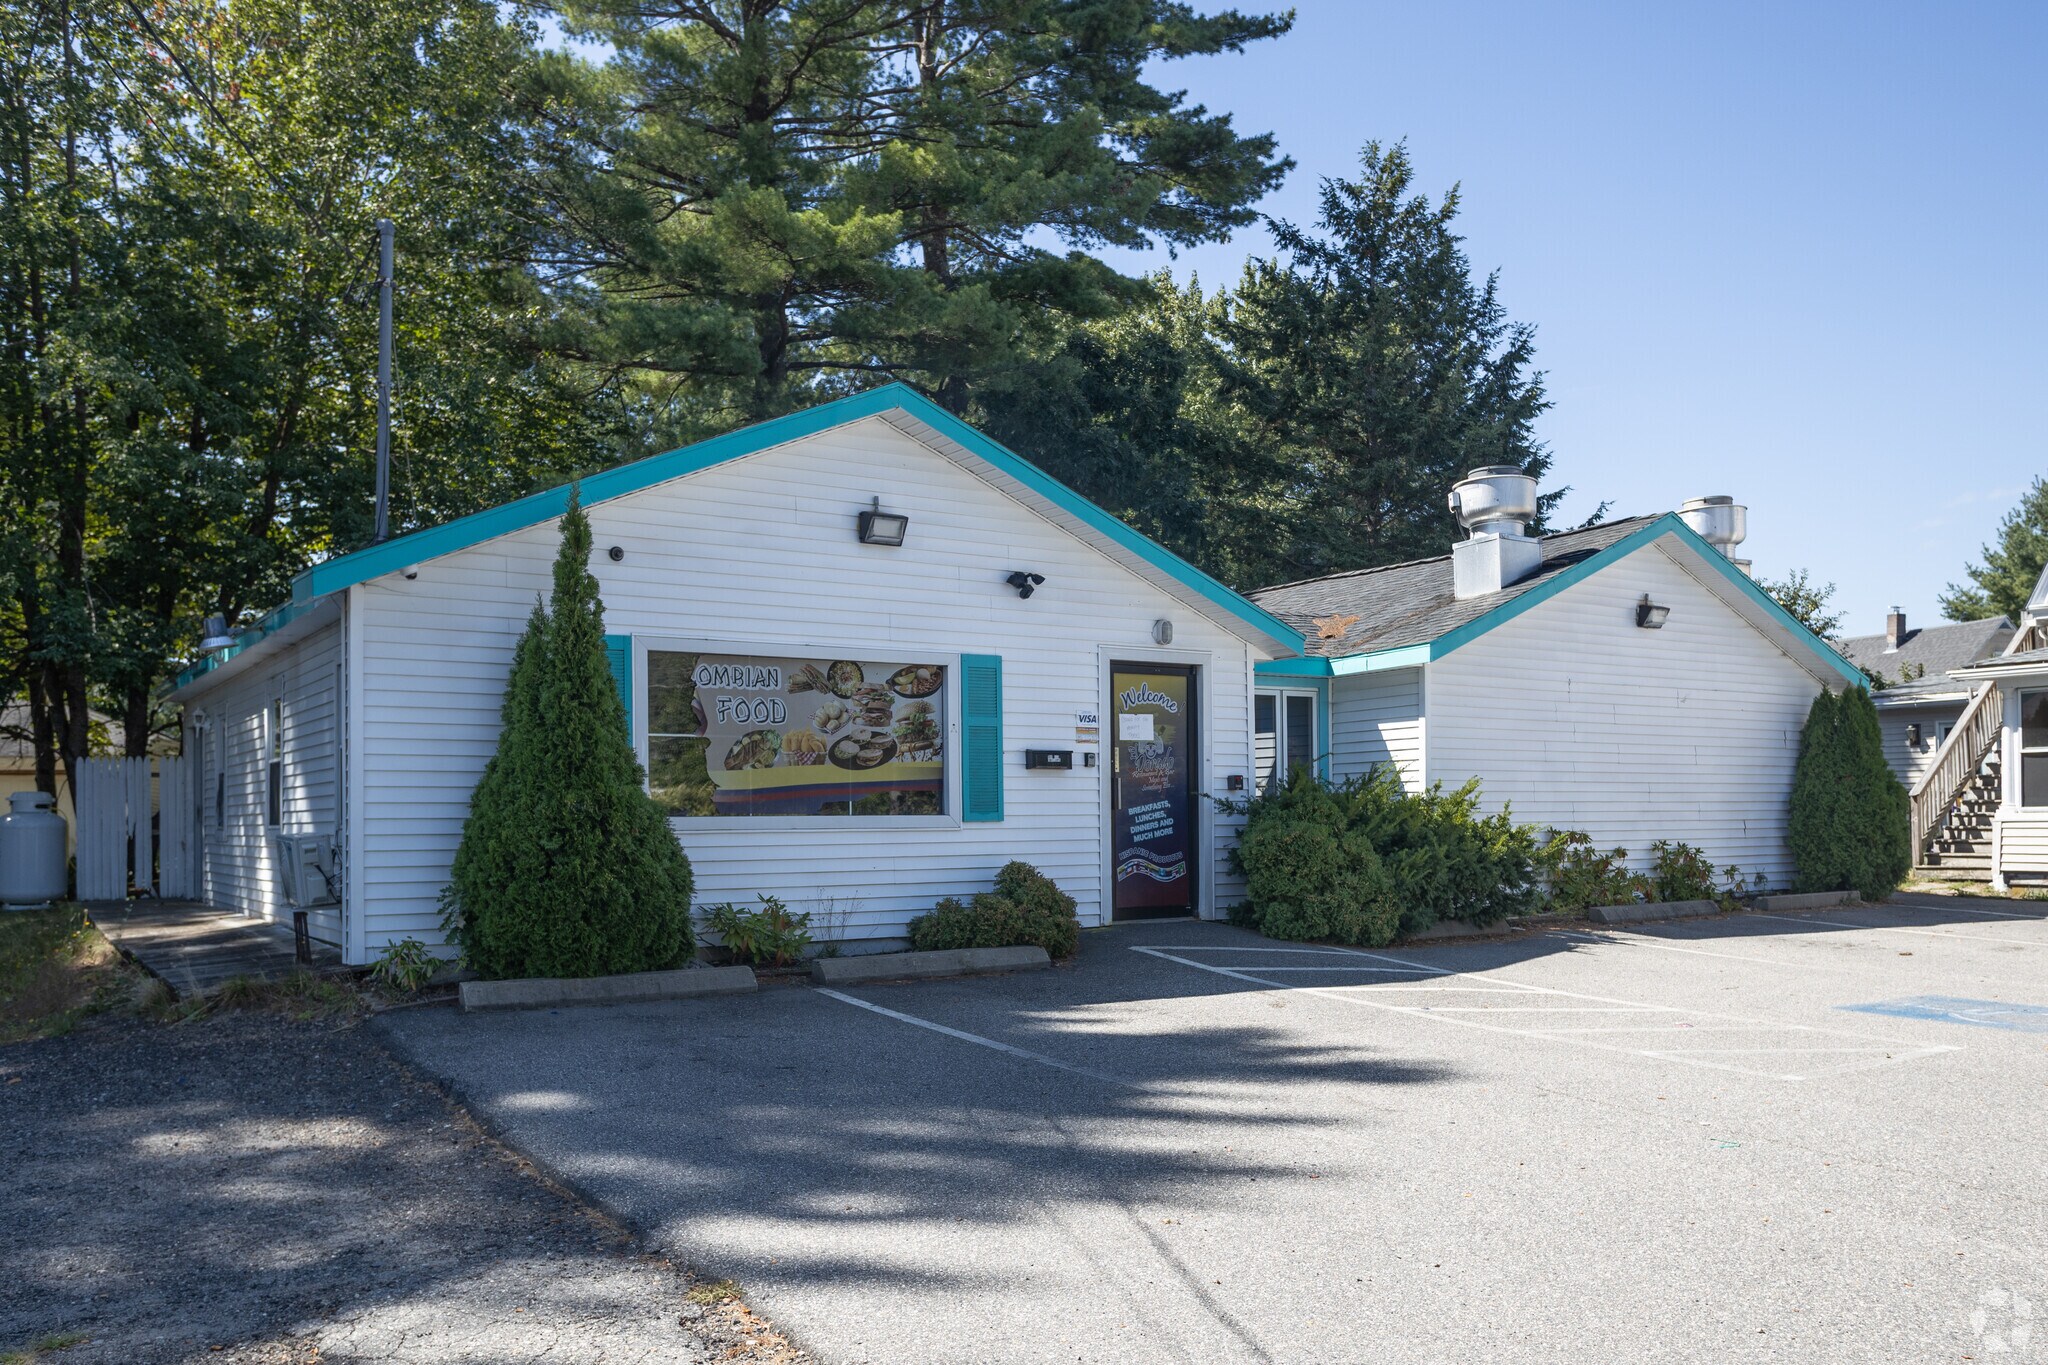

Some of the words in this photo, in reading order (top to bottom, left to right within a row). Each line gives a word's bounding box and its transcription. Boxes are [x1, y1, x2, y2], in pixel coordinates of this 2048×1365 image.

[696, 664, 780, 689] OMBIAN
[717, 695, 787, 725] FOOD
[1078, 714, 1097, 723] VISA
[1128, 800, 1171, 815] BREAKFASTS,
[1135, 811, 1167, 823] LUNCHES,
[1130, 822, 1159, 834] DINNERS
[1160, 818, 1174, 827] AND
[1133, 832, 1153, 842] MUCH
[1154, 827, 1173, 838] MORE
